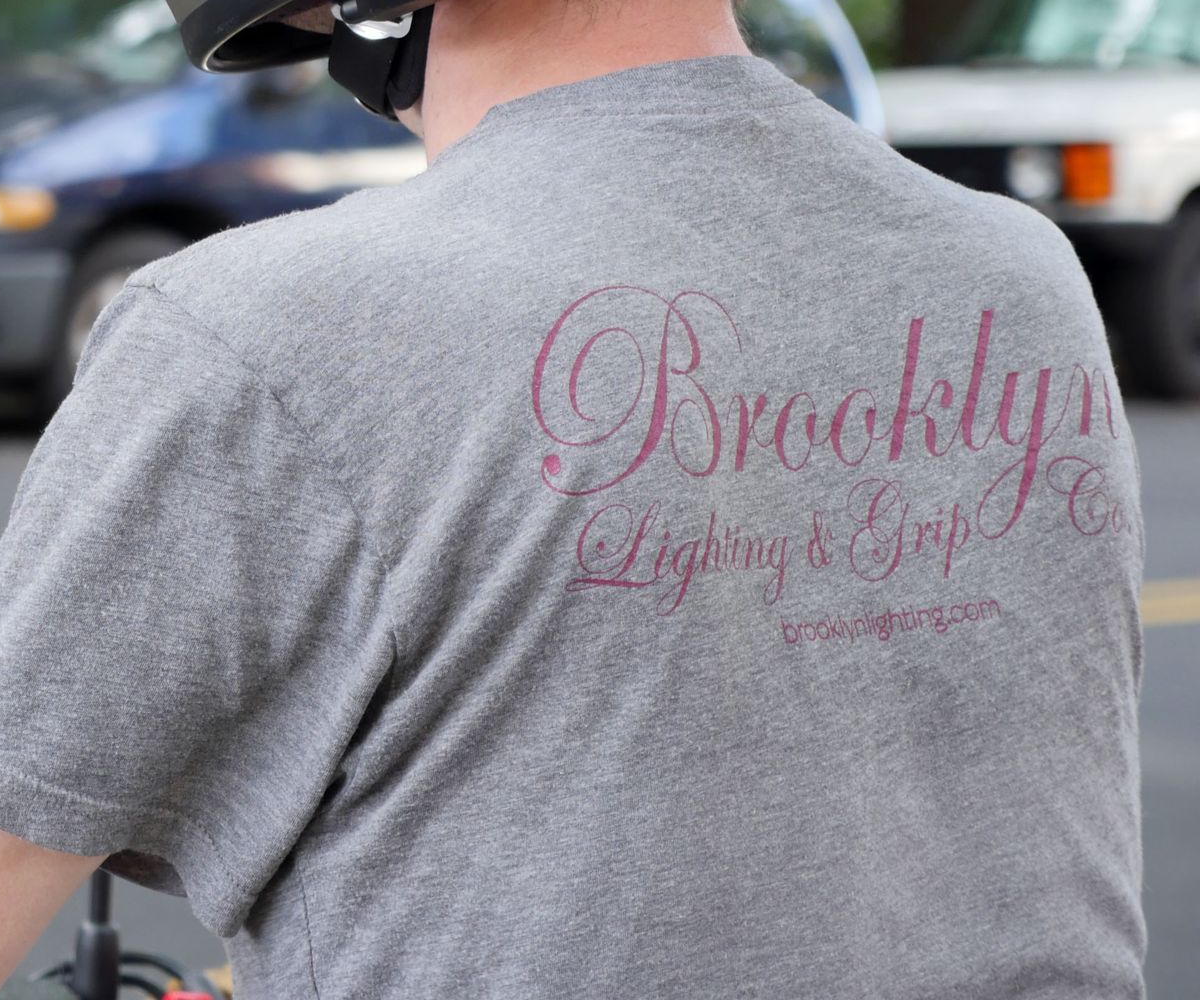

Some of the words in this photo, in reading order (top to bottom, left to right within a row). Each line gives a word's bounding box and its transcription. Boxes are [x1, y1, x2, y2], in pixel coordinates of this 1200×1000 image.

[531, 285, 1119, 540] Brooklyn
[565, 500, 793, 616] Lighting
[806, 510, 834, 570] &
[848, 478, 971, 583] Grip
[780, 599, 1002, 644] brooklynlighting.com
